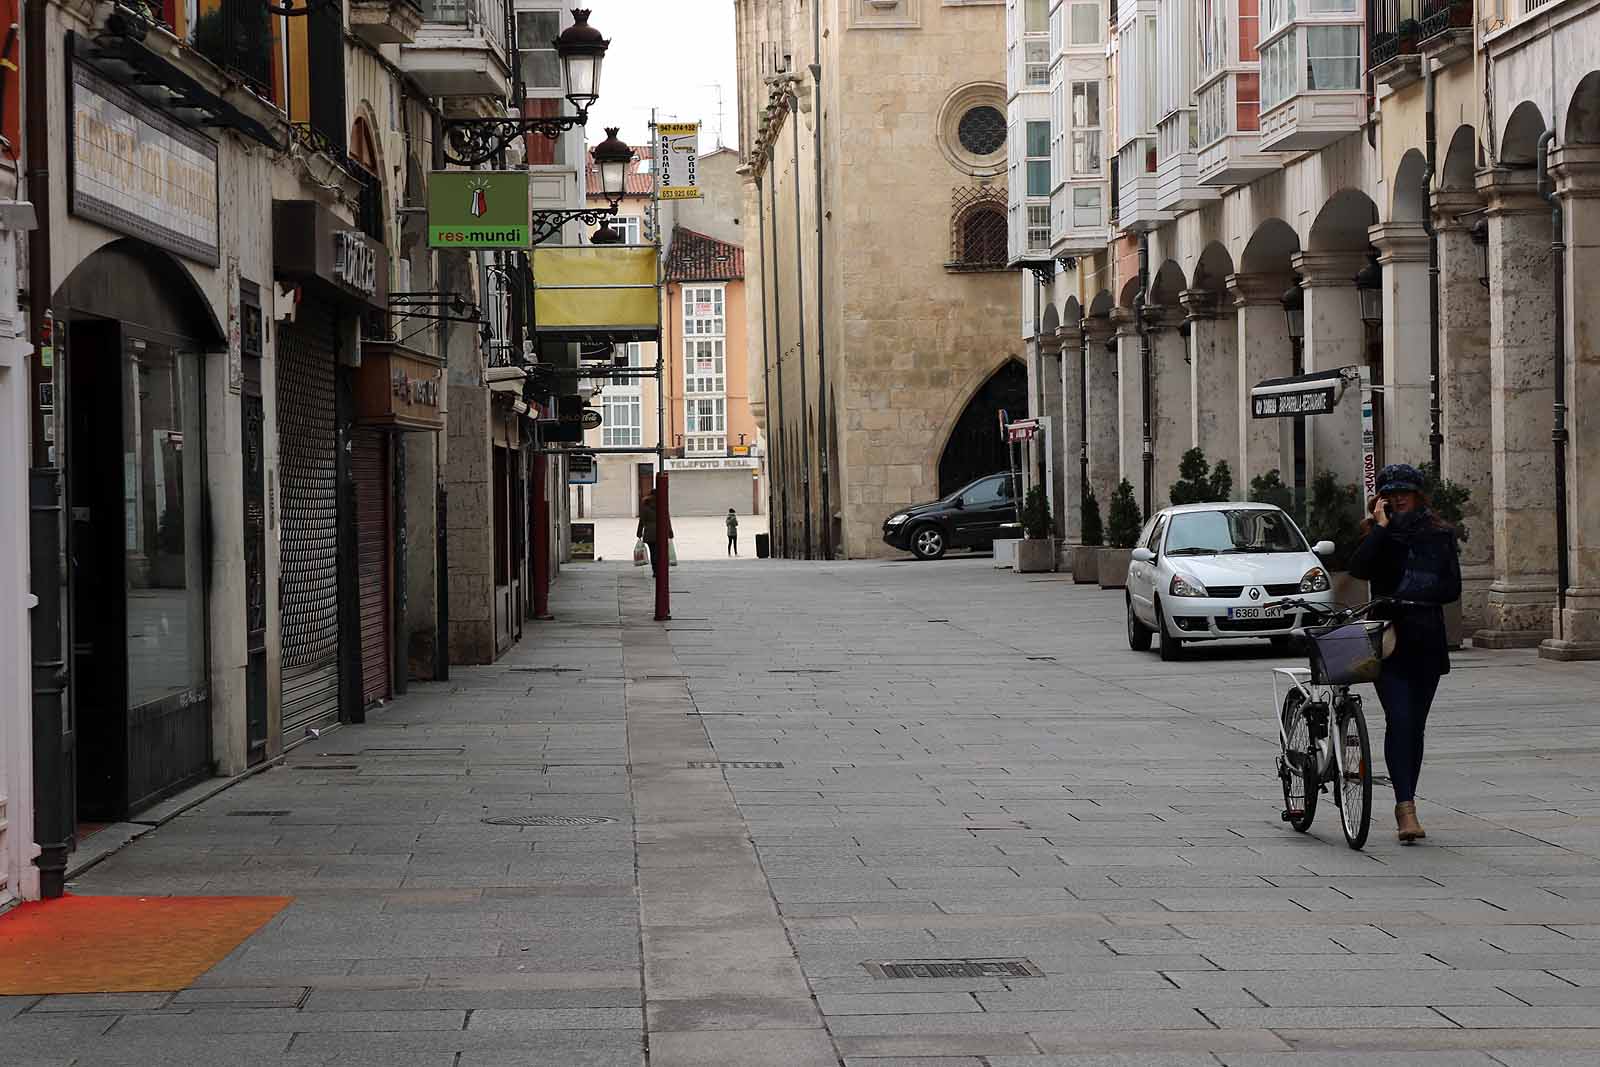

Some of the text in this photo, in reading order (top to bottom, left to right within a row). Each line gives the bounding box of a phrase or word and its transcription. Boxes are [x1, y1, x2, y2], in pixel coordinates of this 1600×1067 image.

[662, 136, 670, 186] ANDAMIOS
[1235, 607, 1281, 618] 6360 GKY
